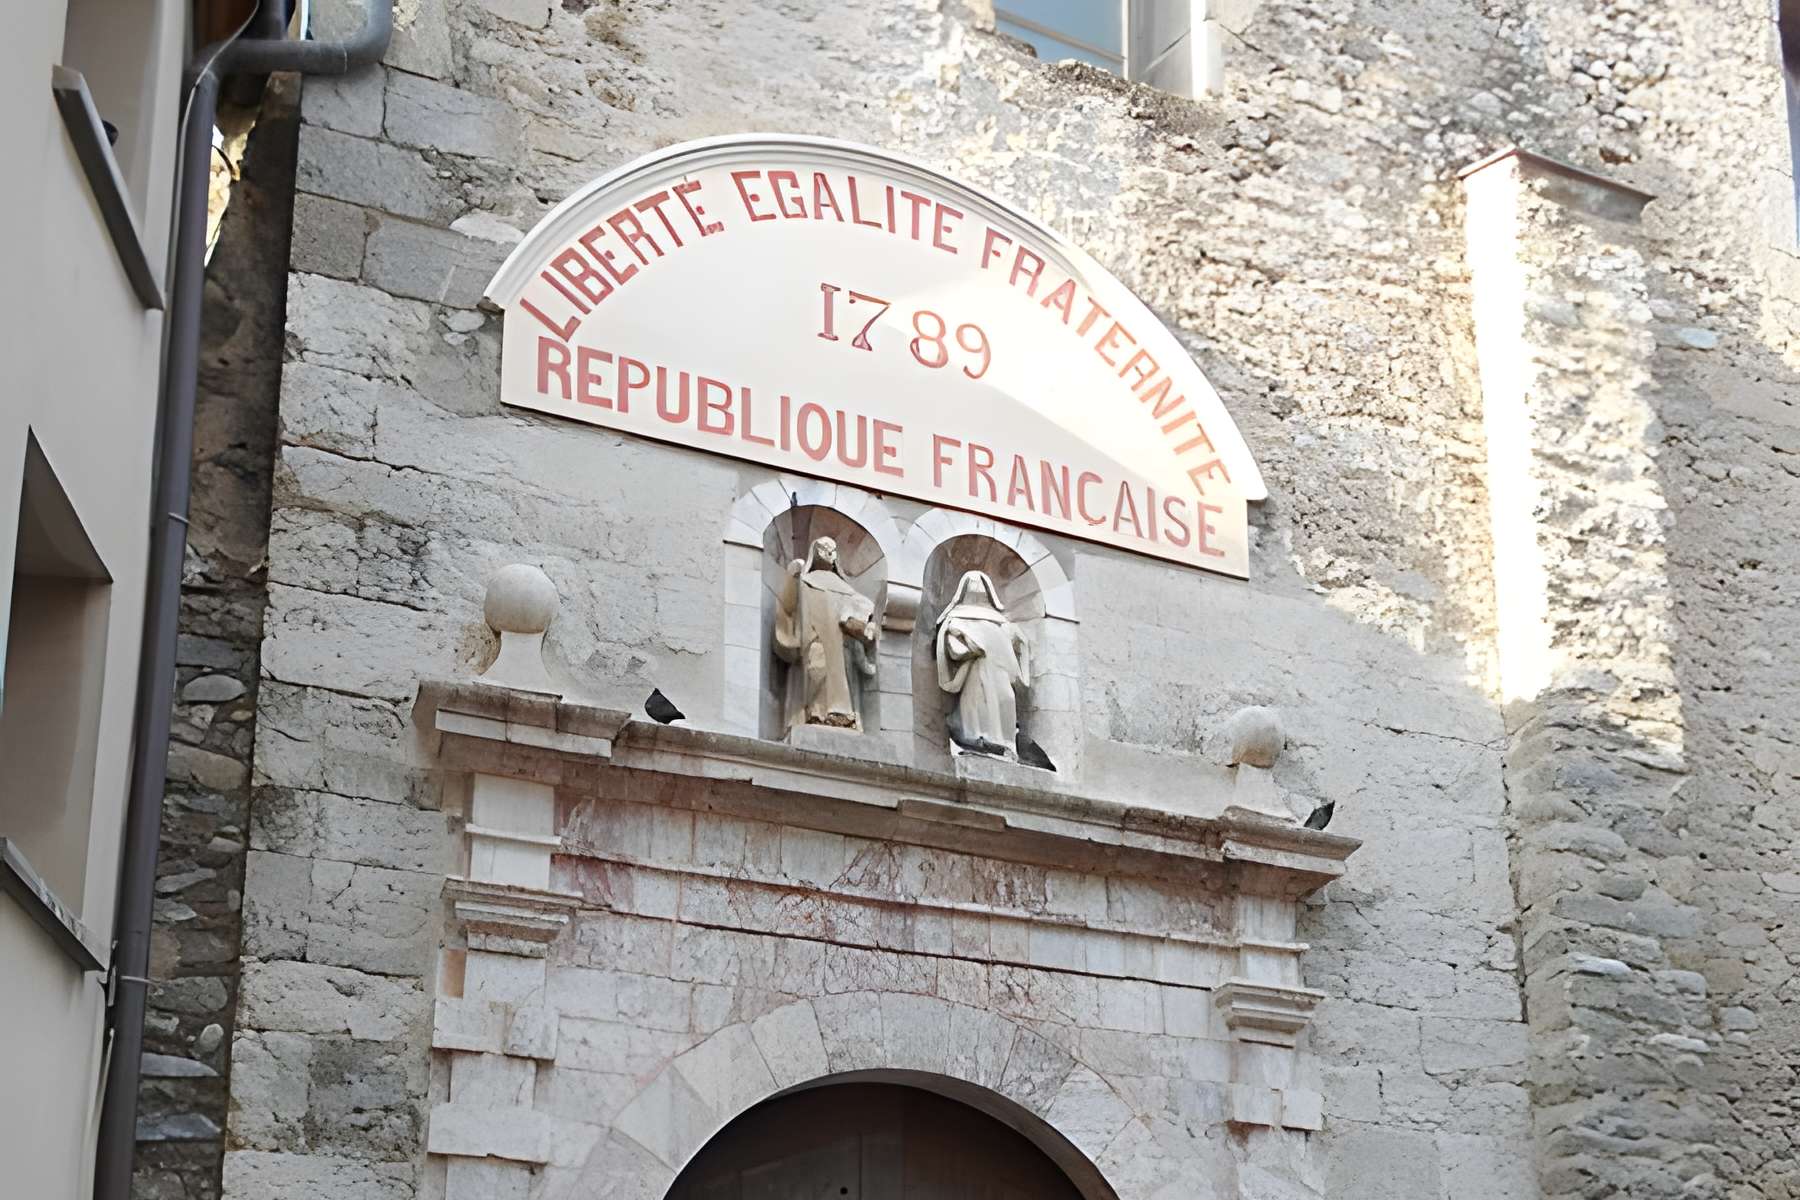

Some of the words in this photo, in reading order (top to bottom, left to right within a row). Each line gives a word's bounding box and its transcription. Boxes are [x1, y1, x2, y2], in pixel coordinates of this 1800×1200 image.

[520, 178, 725, 343] LIBERTE
[731, 170, 964, 255] EGALITE
[981, 227, 1231, 496] FRATERNITE
[819, 283, 992, 380] 1789
